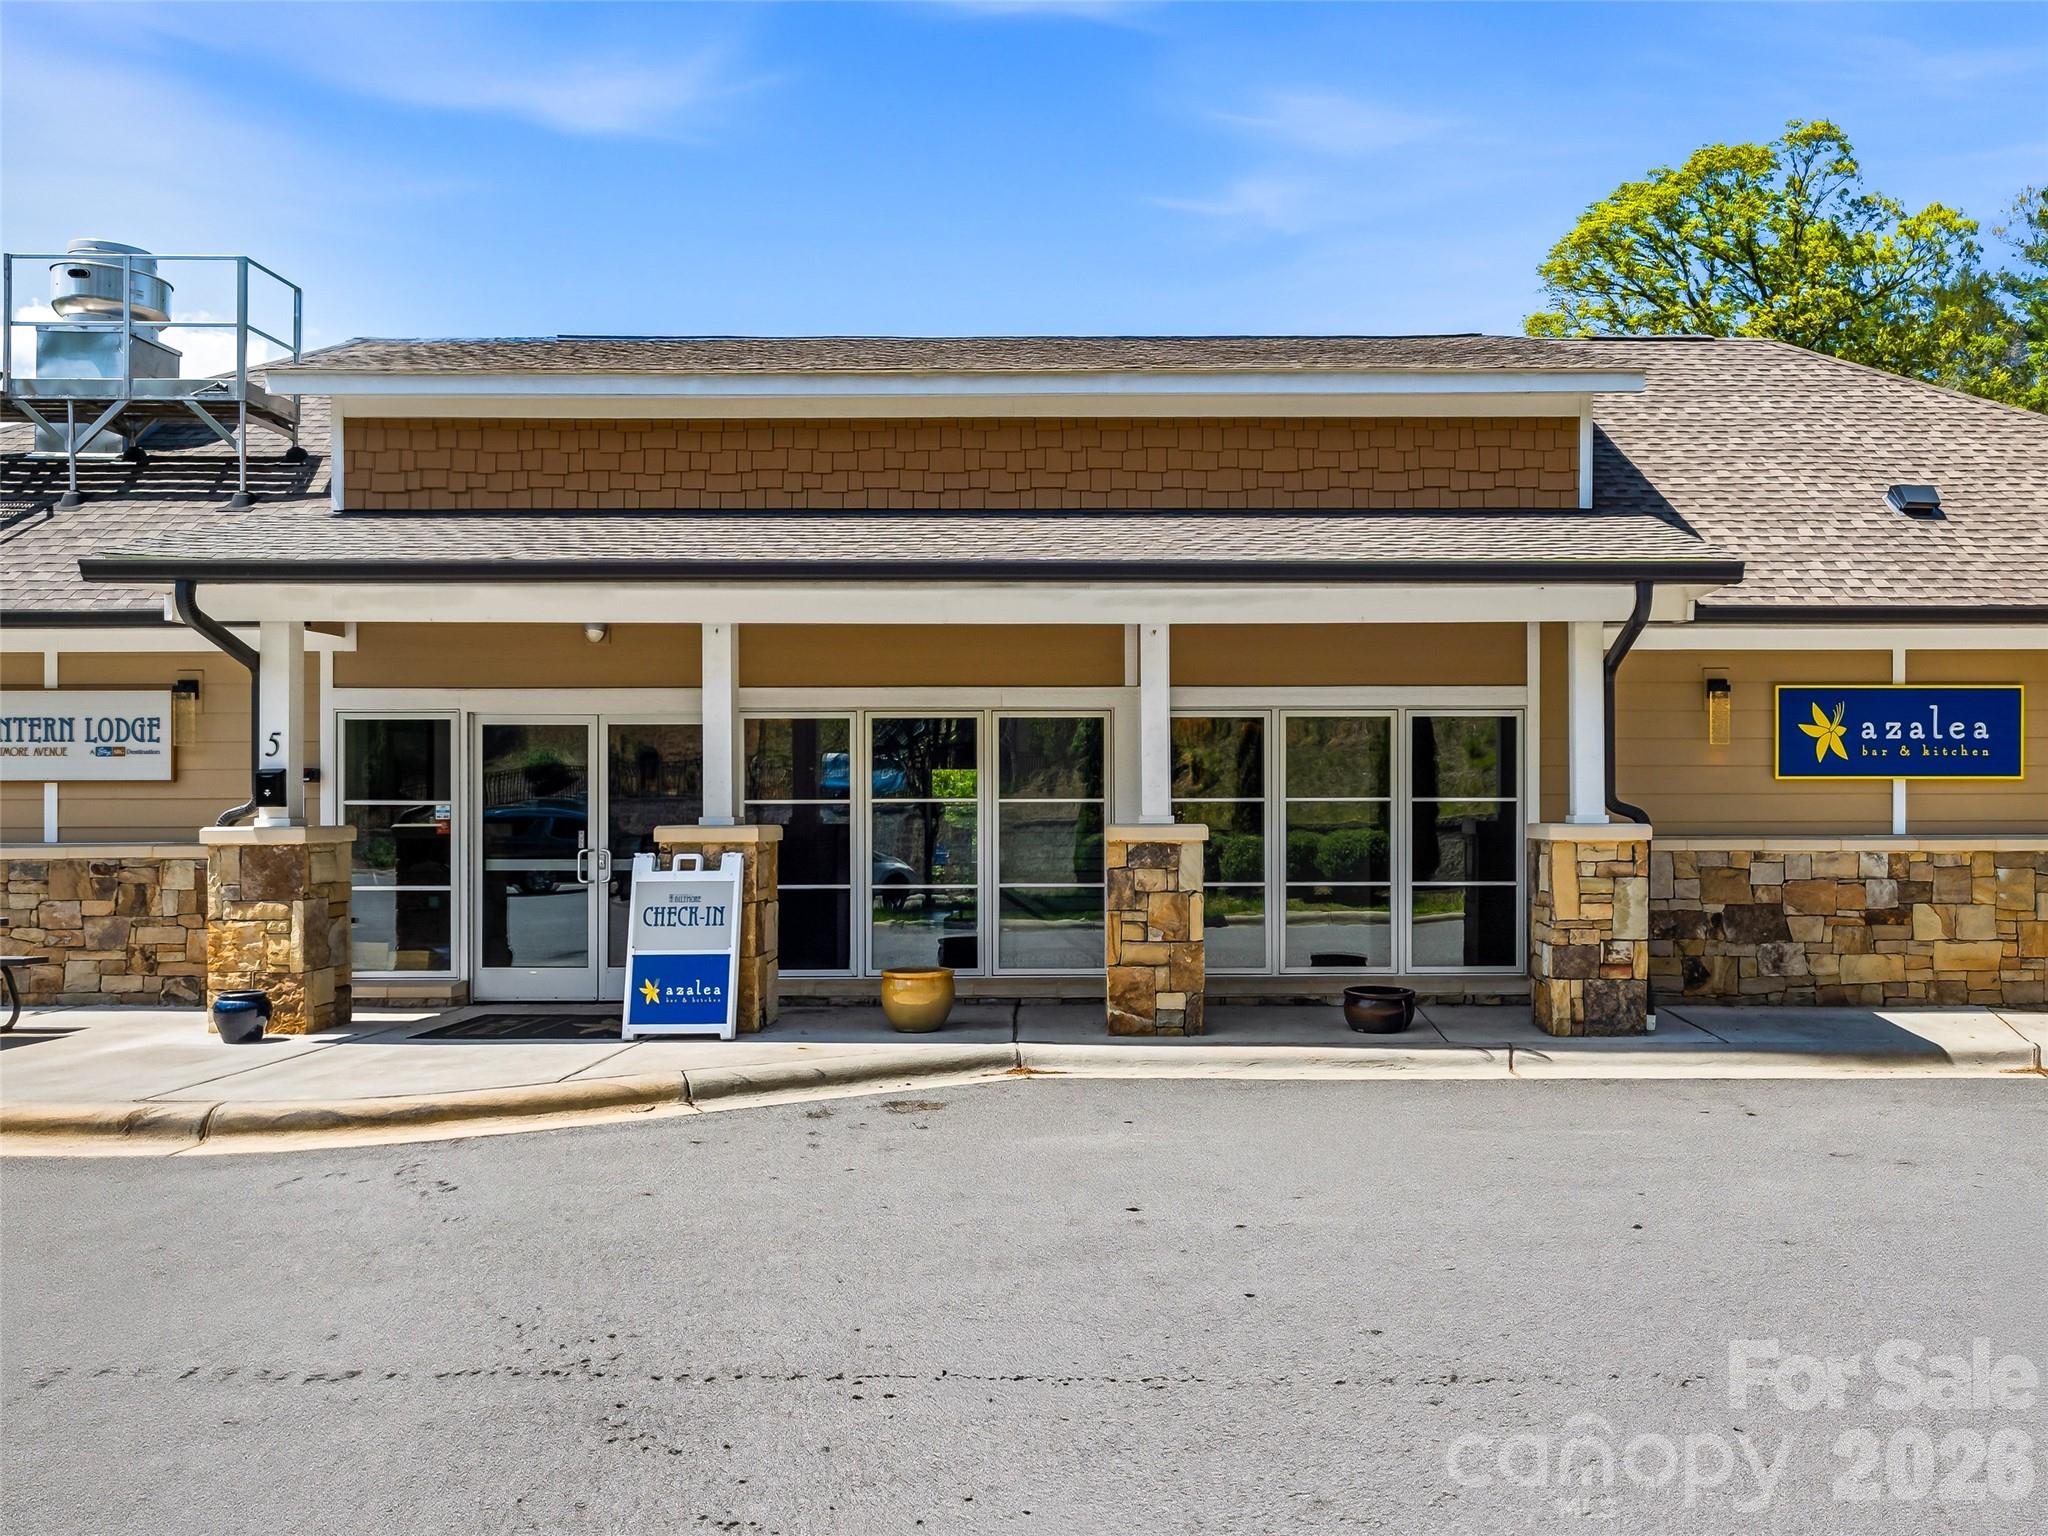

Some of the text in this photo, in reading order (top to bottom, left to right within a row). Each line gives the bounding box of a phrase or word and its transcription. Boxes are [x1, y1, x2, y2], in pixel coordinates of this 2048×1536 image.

[84, 717, 160, 743] LODGE
[1861, 704, 1989, 739] azalea
[33, 747, 68, 756] AVENUE
[265, 732, 281, 757] 5
[1862, 743, 1989, 756] bar & kitchen
[643, 906, 725, 927] CHECK-IN
[666, 980, 721, 995] azalea
